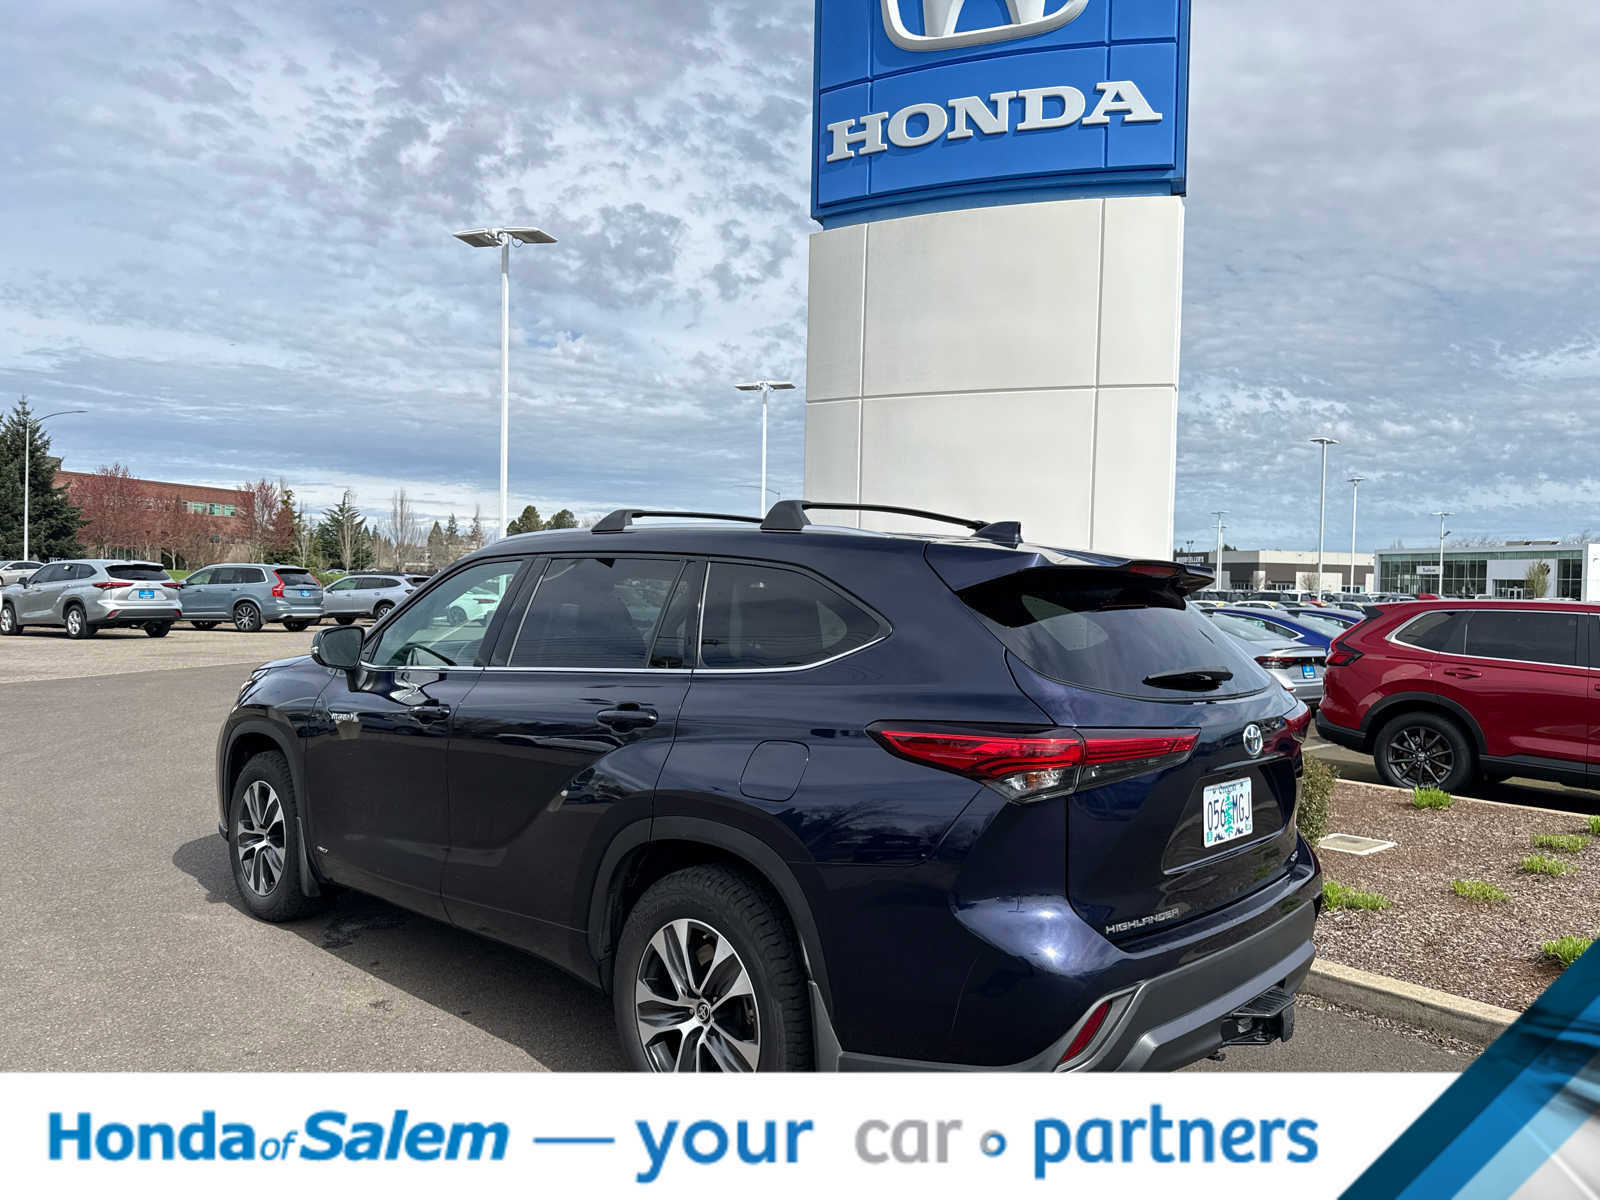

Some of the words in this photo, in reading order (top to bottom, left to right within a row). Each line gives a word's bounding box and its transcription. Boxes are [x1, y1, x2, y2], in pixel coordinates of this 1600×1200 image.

[826, 80, 1163, 163] HONDA
[1207, 799, 1226, 831] 056
[1105, 908, 1179, 935] HIGHLANDER
